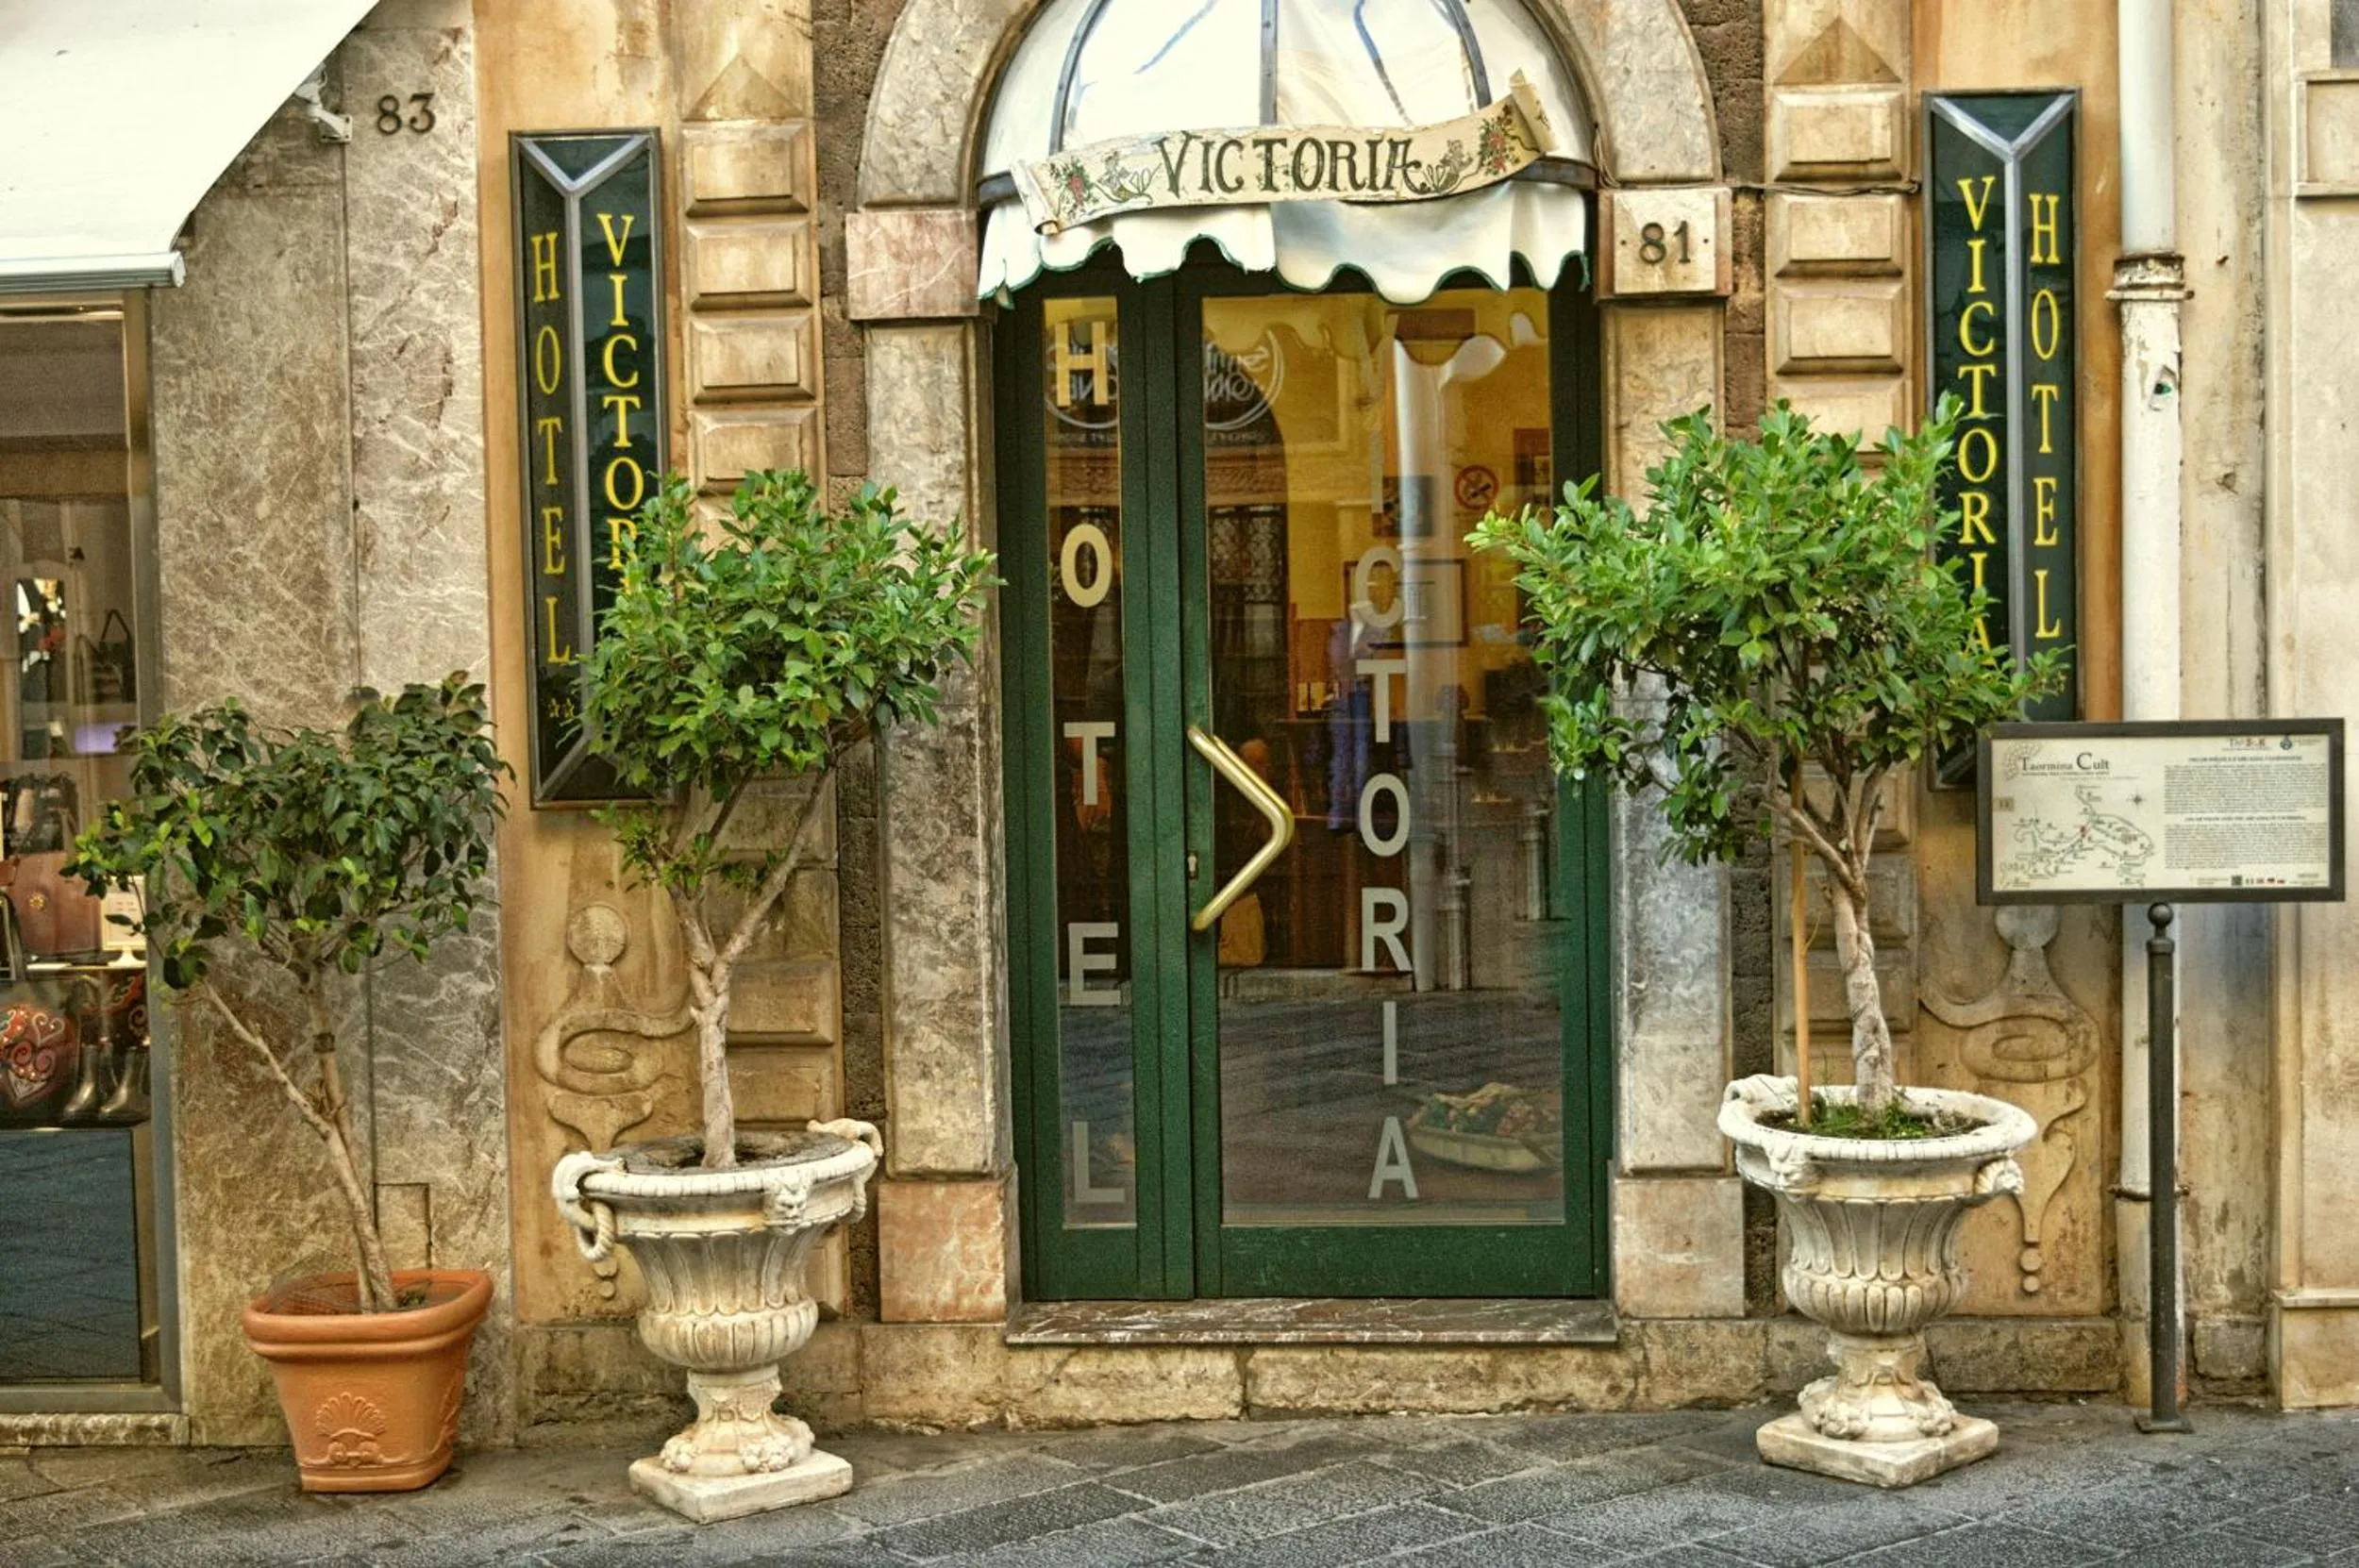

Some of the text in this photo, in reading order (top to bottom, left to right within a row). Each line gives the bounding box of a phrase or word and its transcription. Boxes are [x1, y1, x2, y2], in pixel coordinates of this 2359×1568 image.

[376, 92, 436, 136] 83
[1152, 130, 1427, 199] VICTORIA
[1638, 220, 1692, 265] 81
[530, 232, 571, 664] HOTEL
[596, 212, 644, 596] VICTOR
[2029, 192, 2061, 640] HOTEL
[1054, 321, 1126, 1204] HOTEL
[1350, 312, 1419, 1199] VICTORIA
[2019, 751, 2110, 772] Taormina Cult
